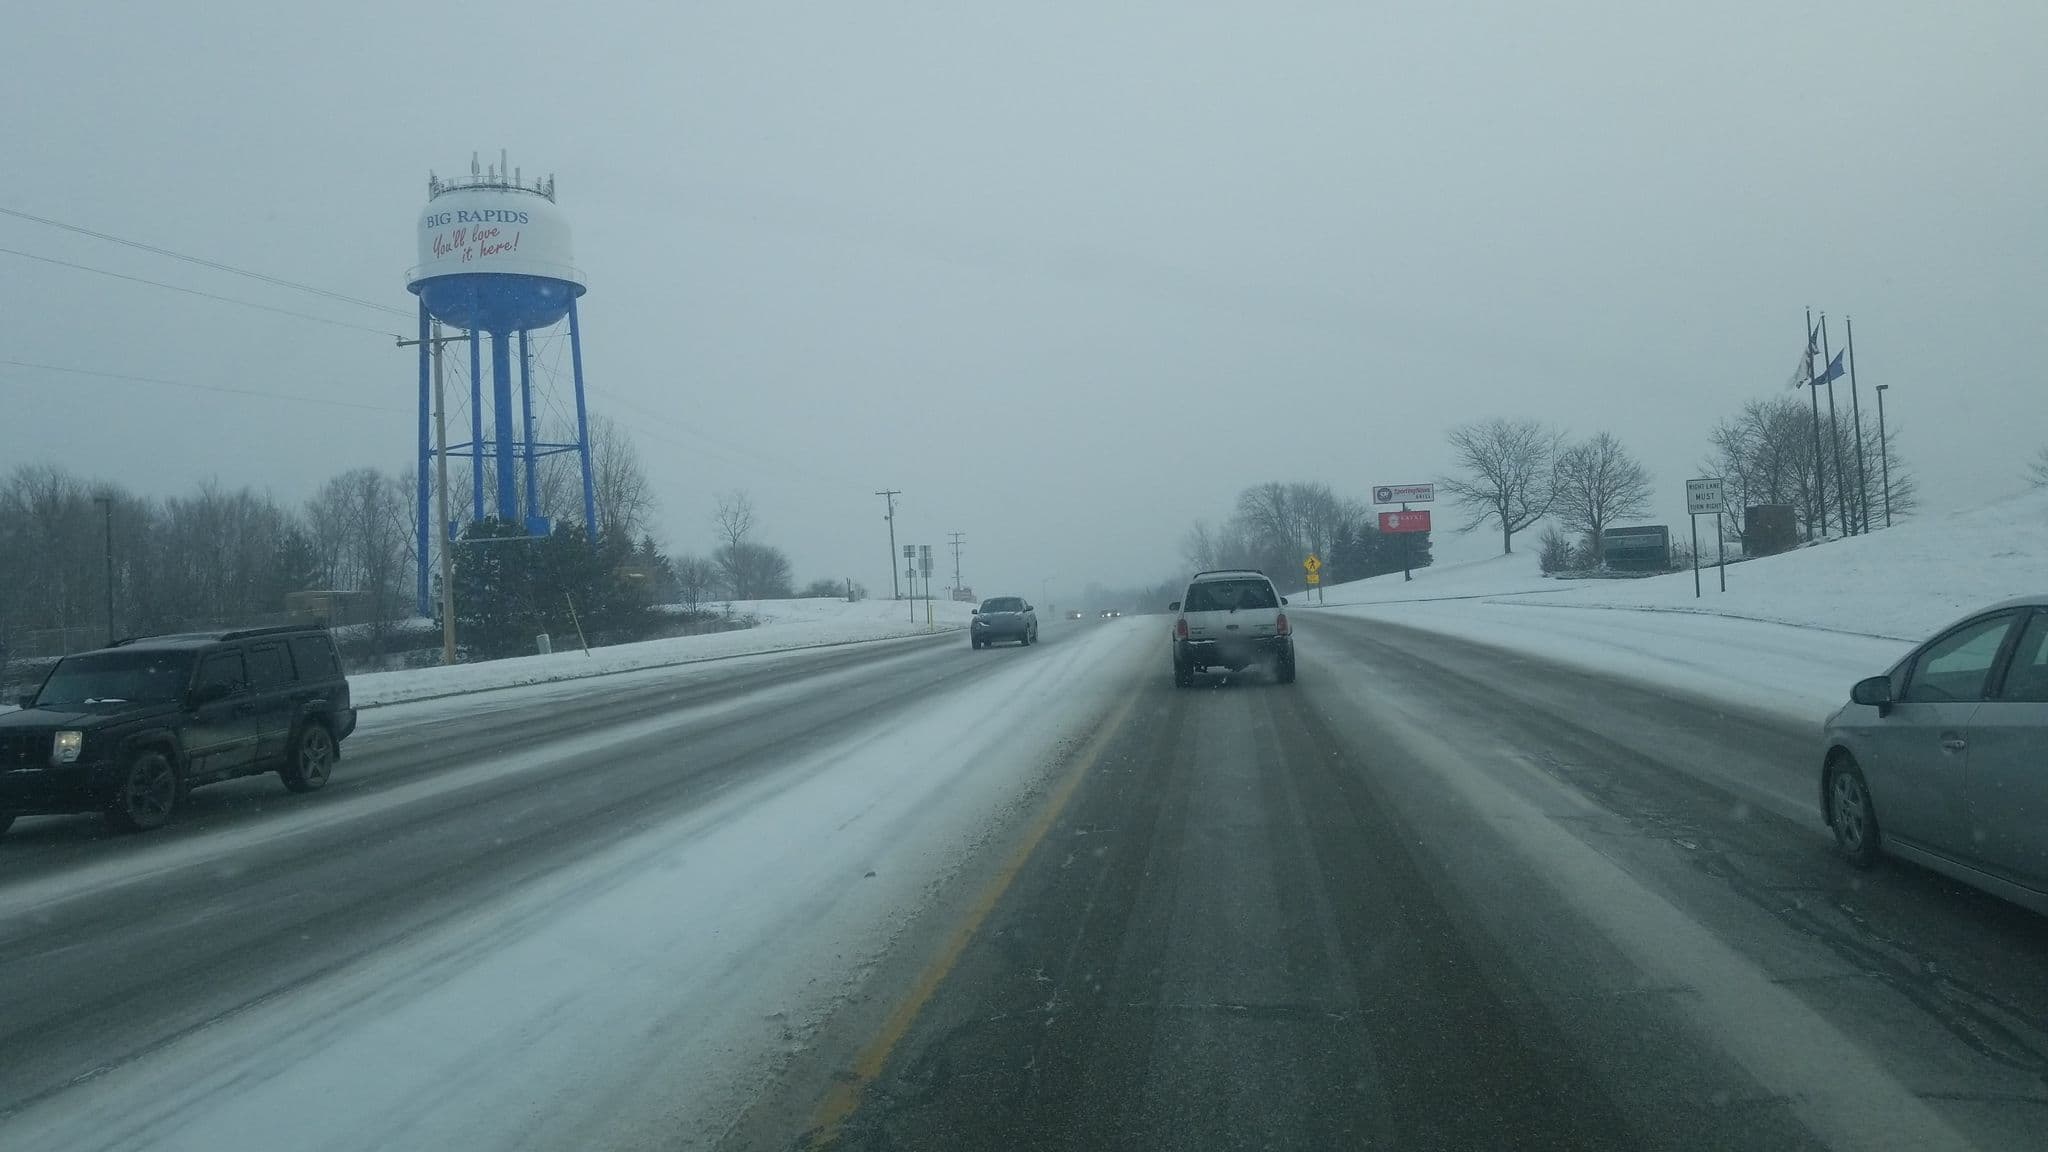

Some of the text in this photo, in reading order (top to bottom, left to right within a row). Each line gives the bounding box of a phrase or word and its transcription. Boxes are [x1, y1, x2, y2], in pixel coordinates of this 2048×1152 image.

[427, 209, 529, 228] BIG RAPIDS
[433, 224, 501, 258] You'll love
[462, 232, 520, 263] it here!
[1695, 492, 1714, 500] MUST
